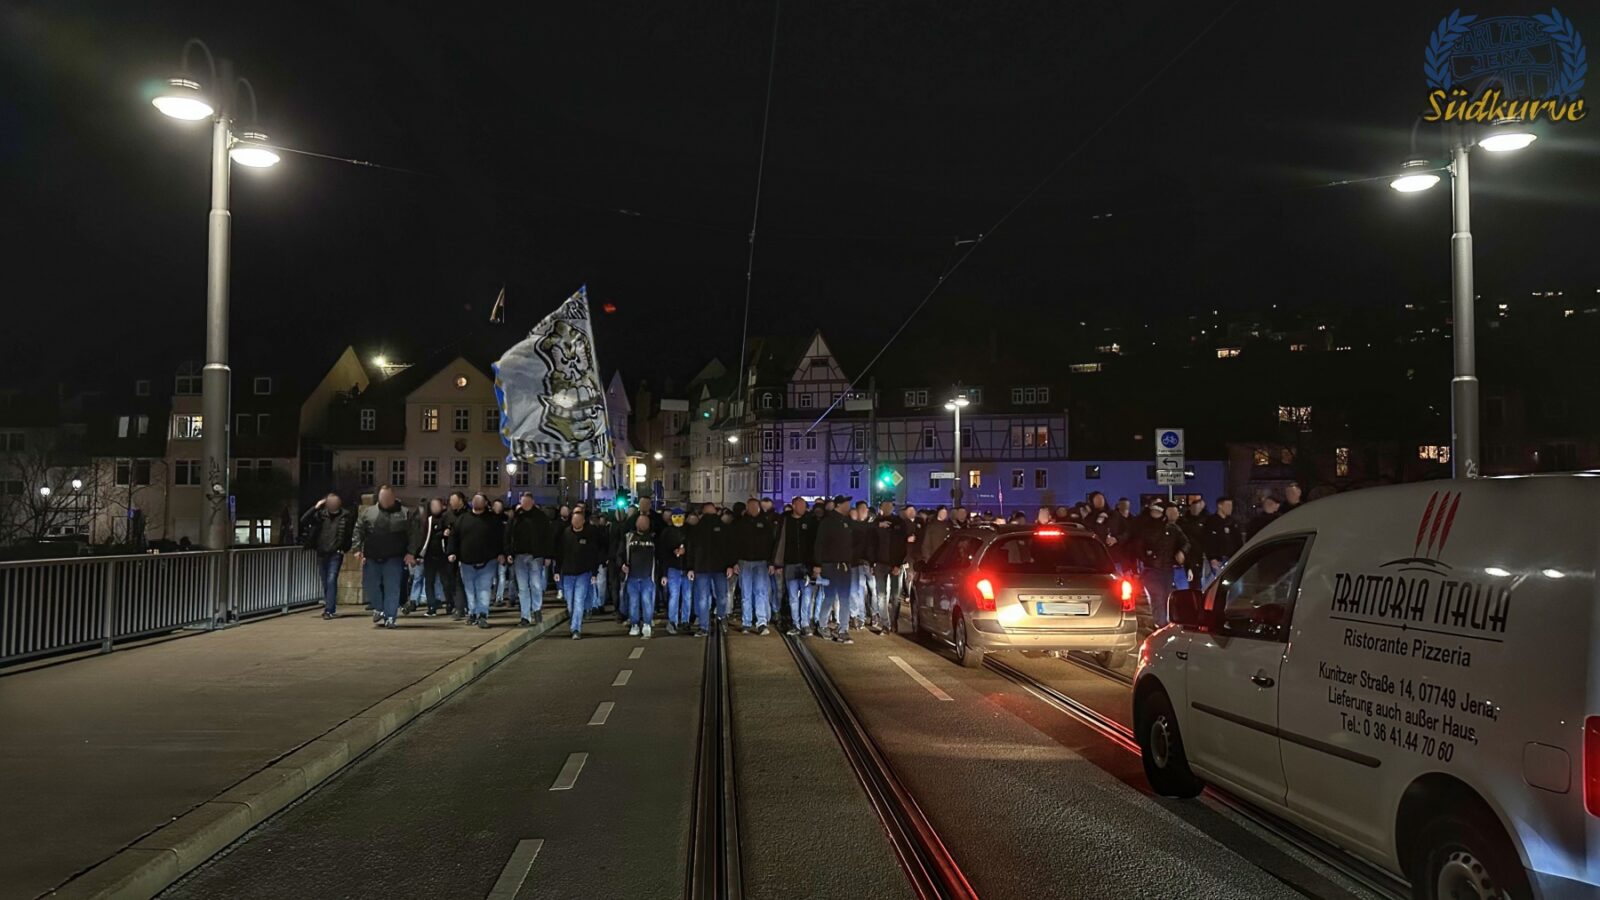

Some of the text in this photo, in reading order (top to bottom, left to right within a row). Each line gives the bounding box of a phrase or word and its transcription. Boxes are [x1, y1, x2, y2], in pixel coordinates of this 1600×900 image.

[1331, 573, 1511, 632] TRATTORIA ITALIA
[1343, 628, 1471, 667] Ristorante Pizzeria
[1319, 661, 1498, 722] Kunitzer Straße 14, 07749 Jena,
[1328, 685, 1478, 745] Lieferung auch außer Haus,
[1340, 712, 1454, 762] Tel.: 0 36 41.44 70 60
